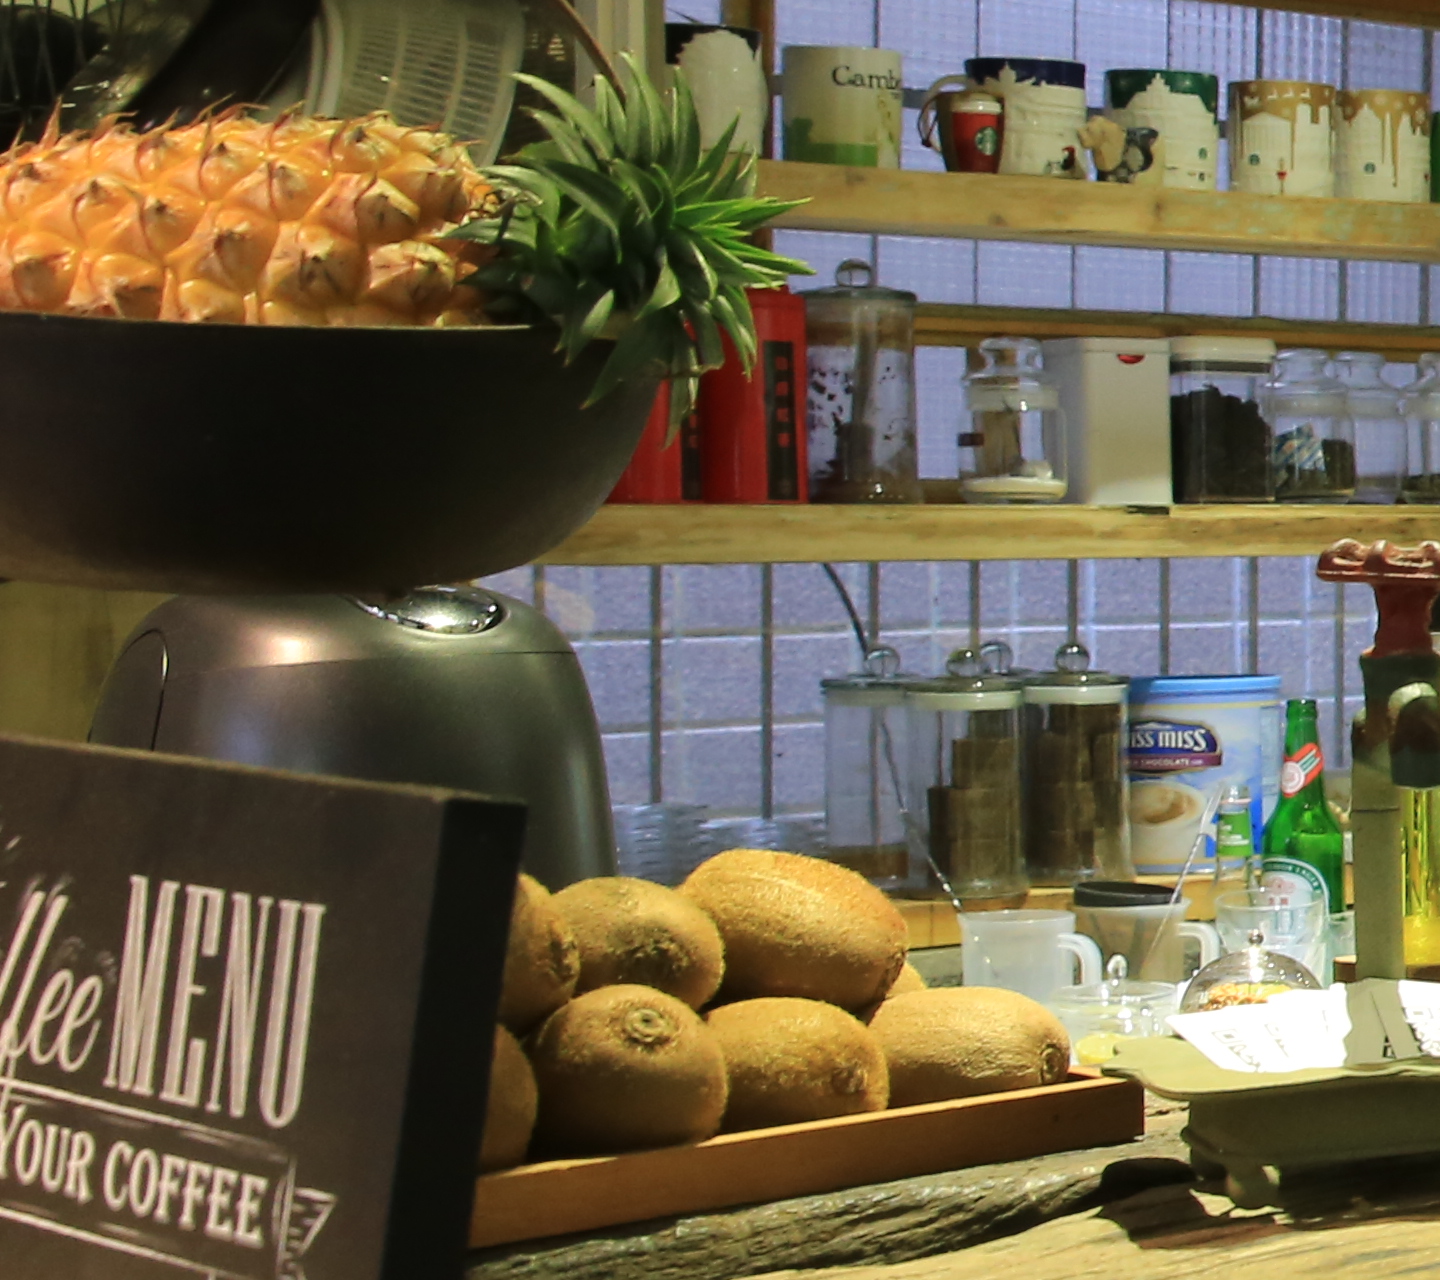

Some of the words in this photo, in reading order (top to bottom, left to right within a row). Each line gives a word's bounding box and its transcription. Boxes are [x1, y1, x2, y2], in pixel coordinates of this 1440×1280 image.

[1158, 729, 1207, 752] MISS
[103, 874, 327, 1128] MENU
[0, 1104, 93, 1205] YOUR
[102, 1139, 269, 1249] COFFEE
